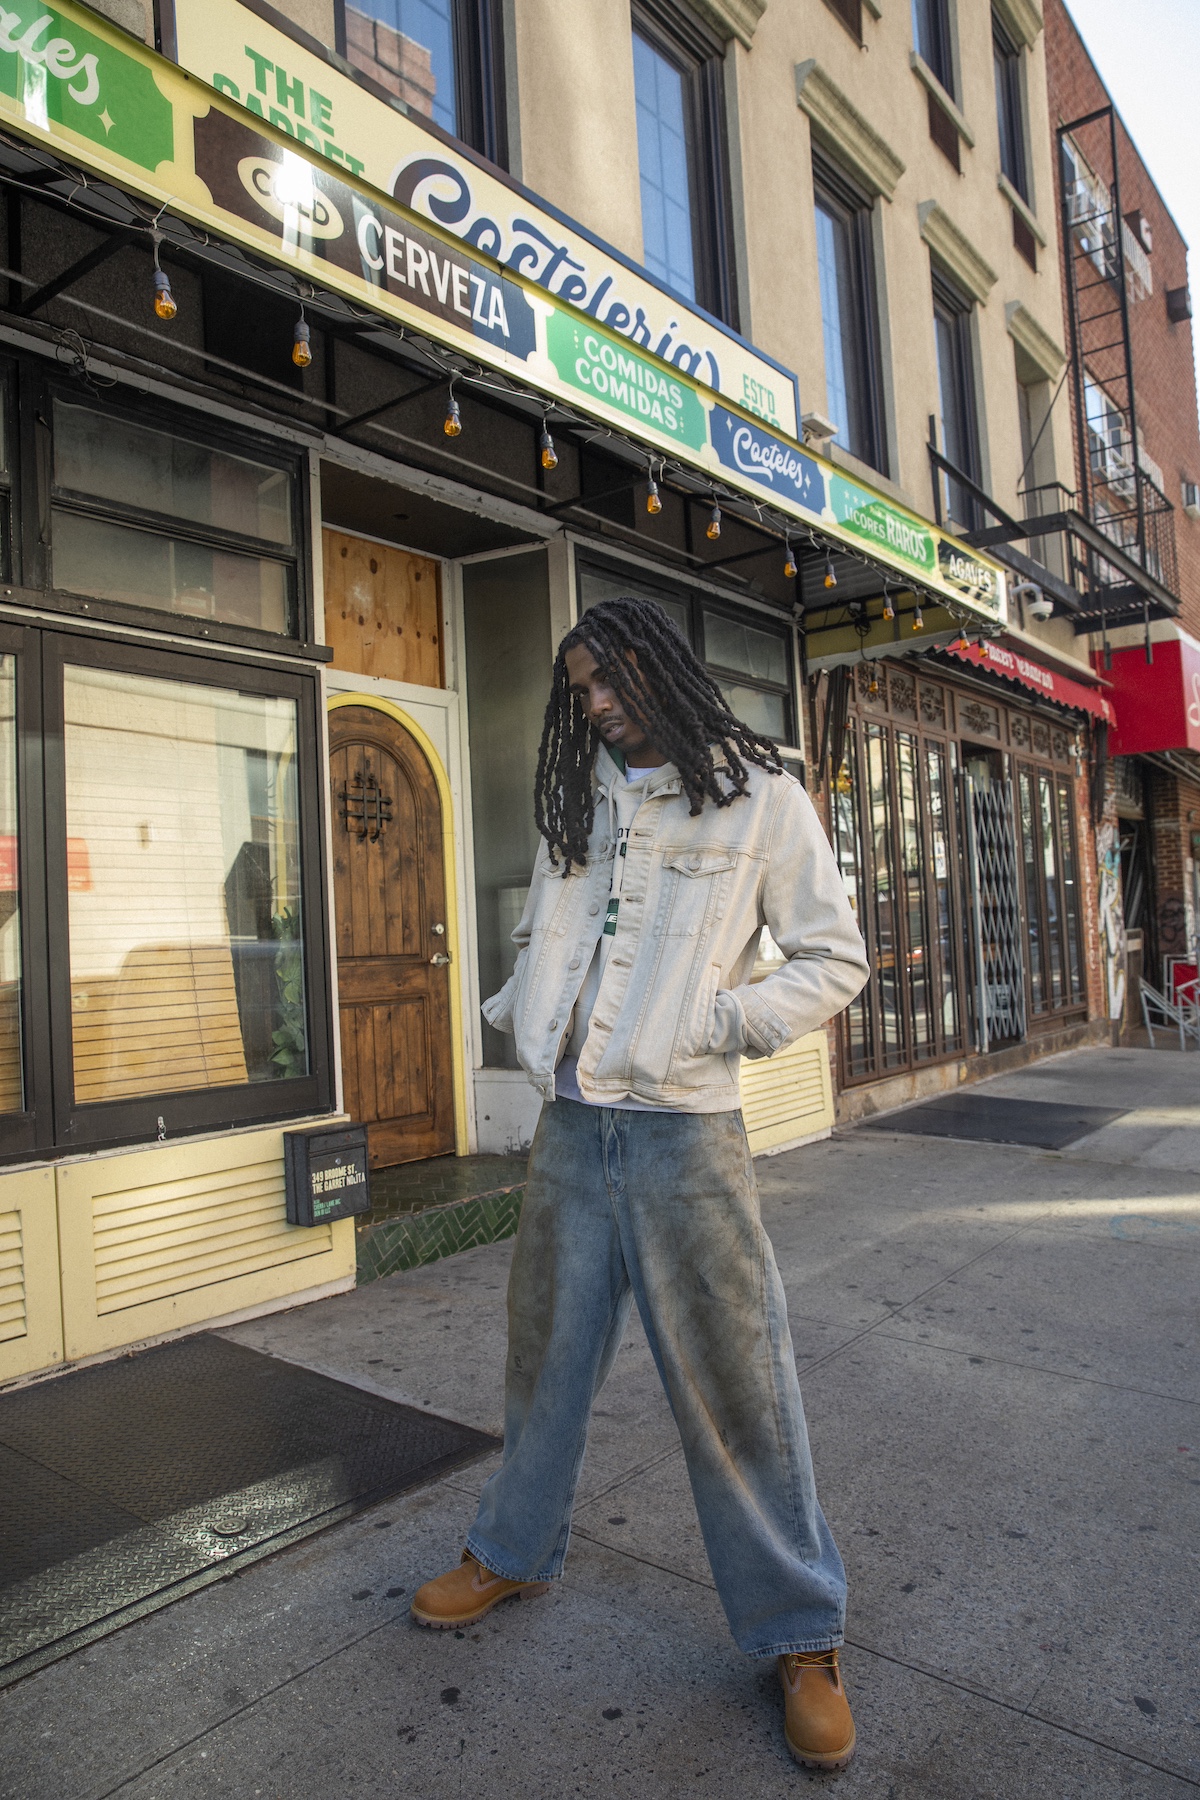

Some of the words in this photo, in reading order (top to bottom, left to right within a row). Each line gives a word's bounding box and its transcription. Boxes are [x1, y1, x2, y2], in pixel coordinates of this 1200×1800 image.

[244, 44, 335, 138] THE
[357, 214, 511, 339] CERVEZA
[575, 357, 678, 431] COMIDAS
[583, 335, 684, 409] COMIDAS
[742, 373, 776, 416] EST'D
[733, 427, 803, 489] Cocteles
[844, 504, 886, 540] LICORES
[885, 513, 927, 562] RAROS
[949, 554, 992, 592] AGAVES
[311, 1172, 324, 1184] 349
[324, 1166, 347, 1180] BROOME
[347, 1163, 358, 1175] ST.
[312, 1182, 324, 1195] THE
[324, 1177, 346, 1192] GARRET
